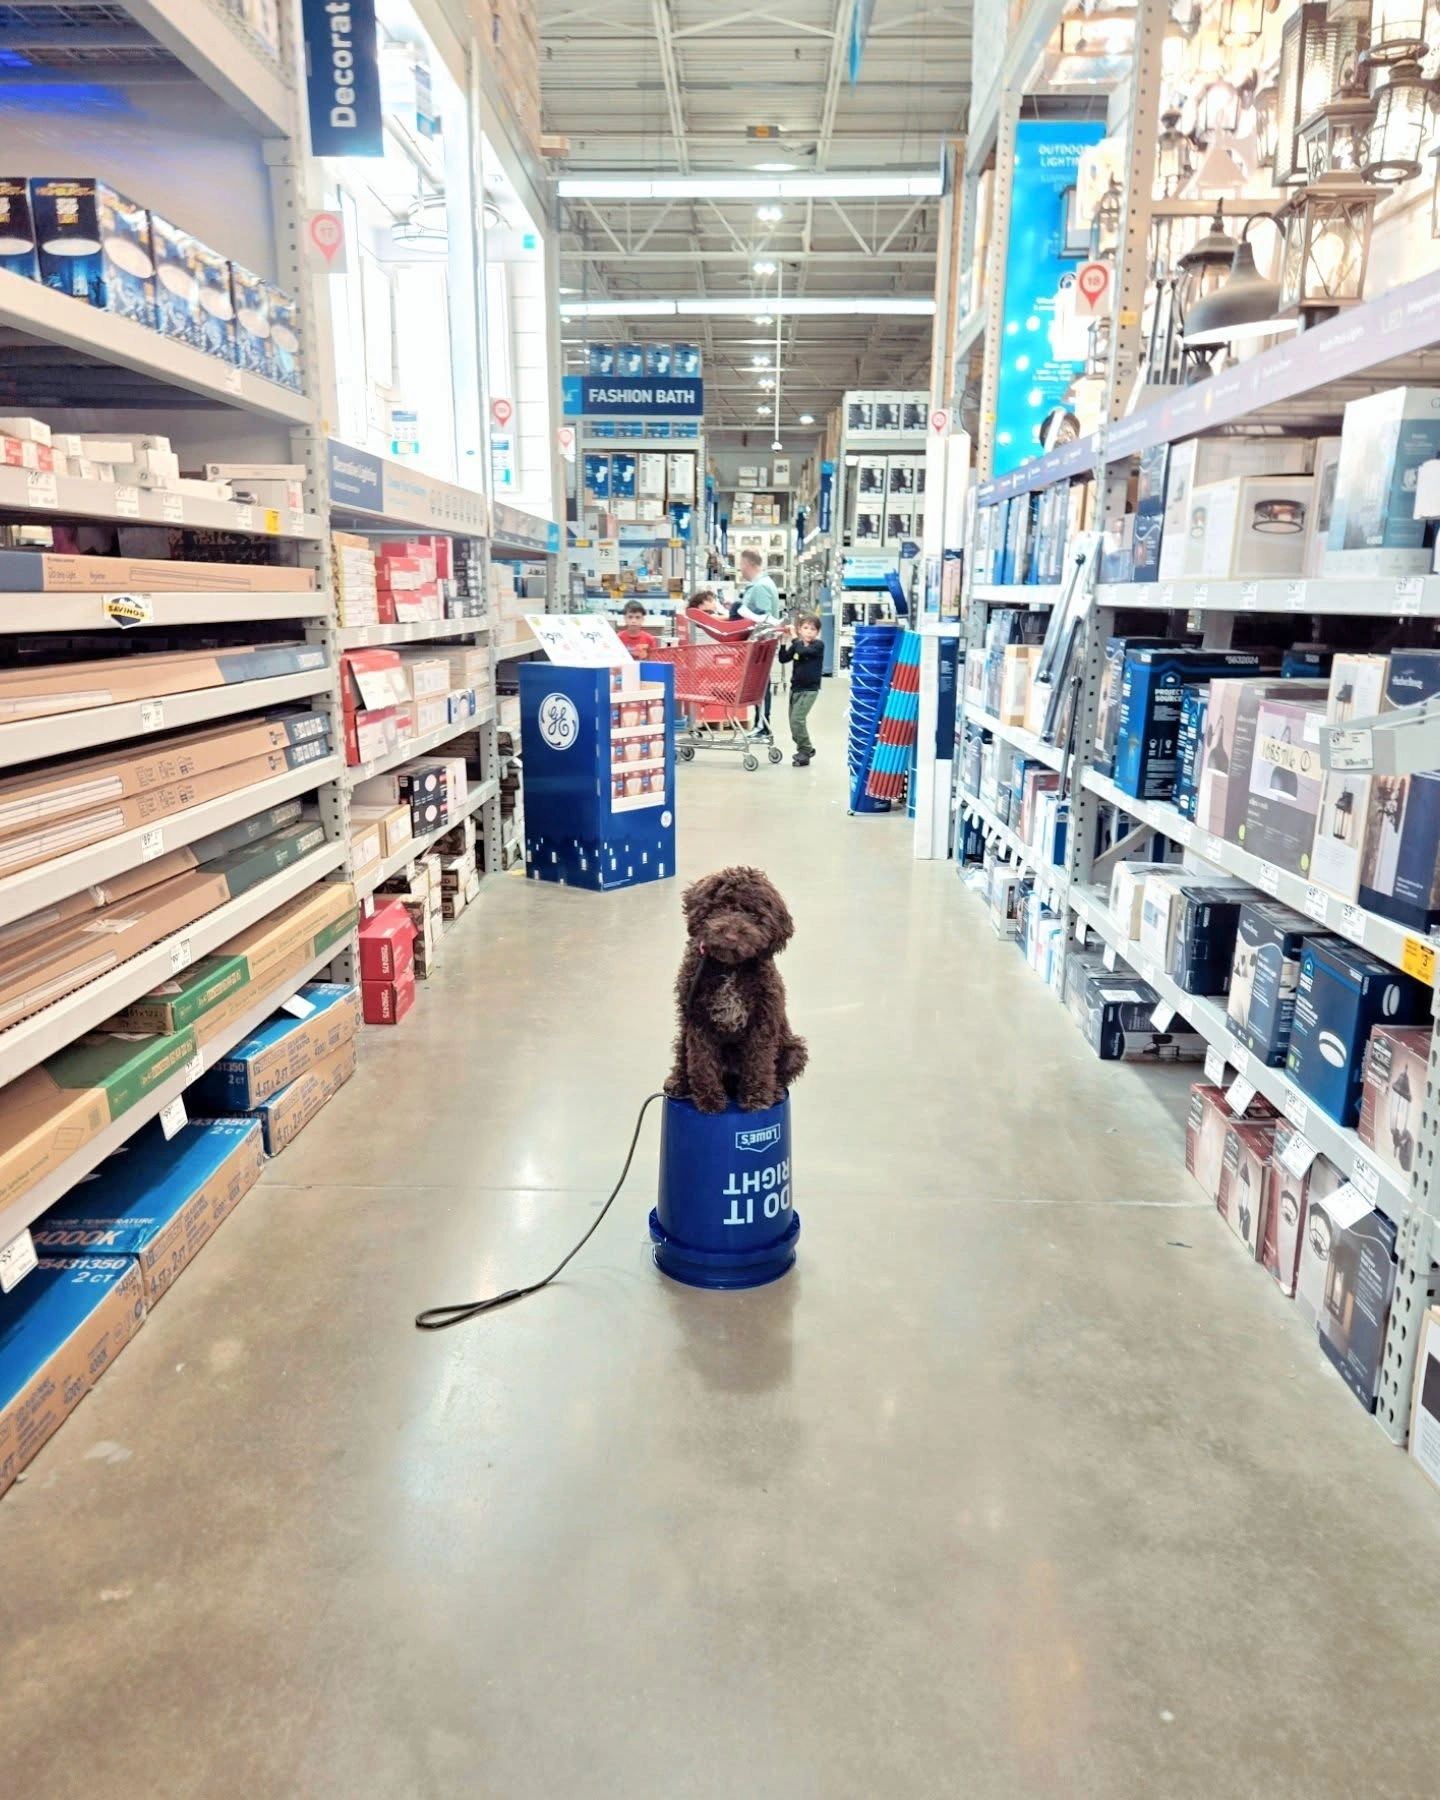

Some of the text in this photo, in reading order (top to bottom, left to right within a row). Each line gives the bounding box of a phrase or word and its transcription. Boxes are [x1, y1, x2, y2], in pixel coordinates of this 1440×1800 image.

[588, 388, 695, 404] FASHION BATH
[108, 605, 145, 618] SAVINGS
[210, 1126, 244, 1135] 2 CT
[722, 1157, 790, 1195] RIGHT
[723, 1183, 790, 1225] DO IT
[71, 1271, 115, 1284] 2 CT
